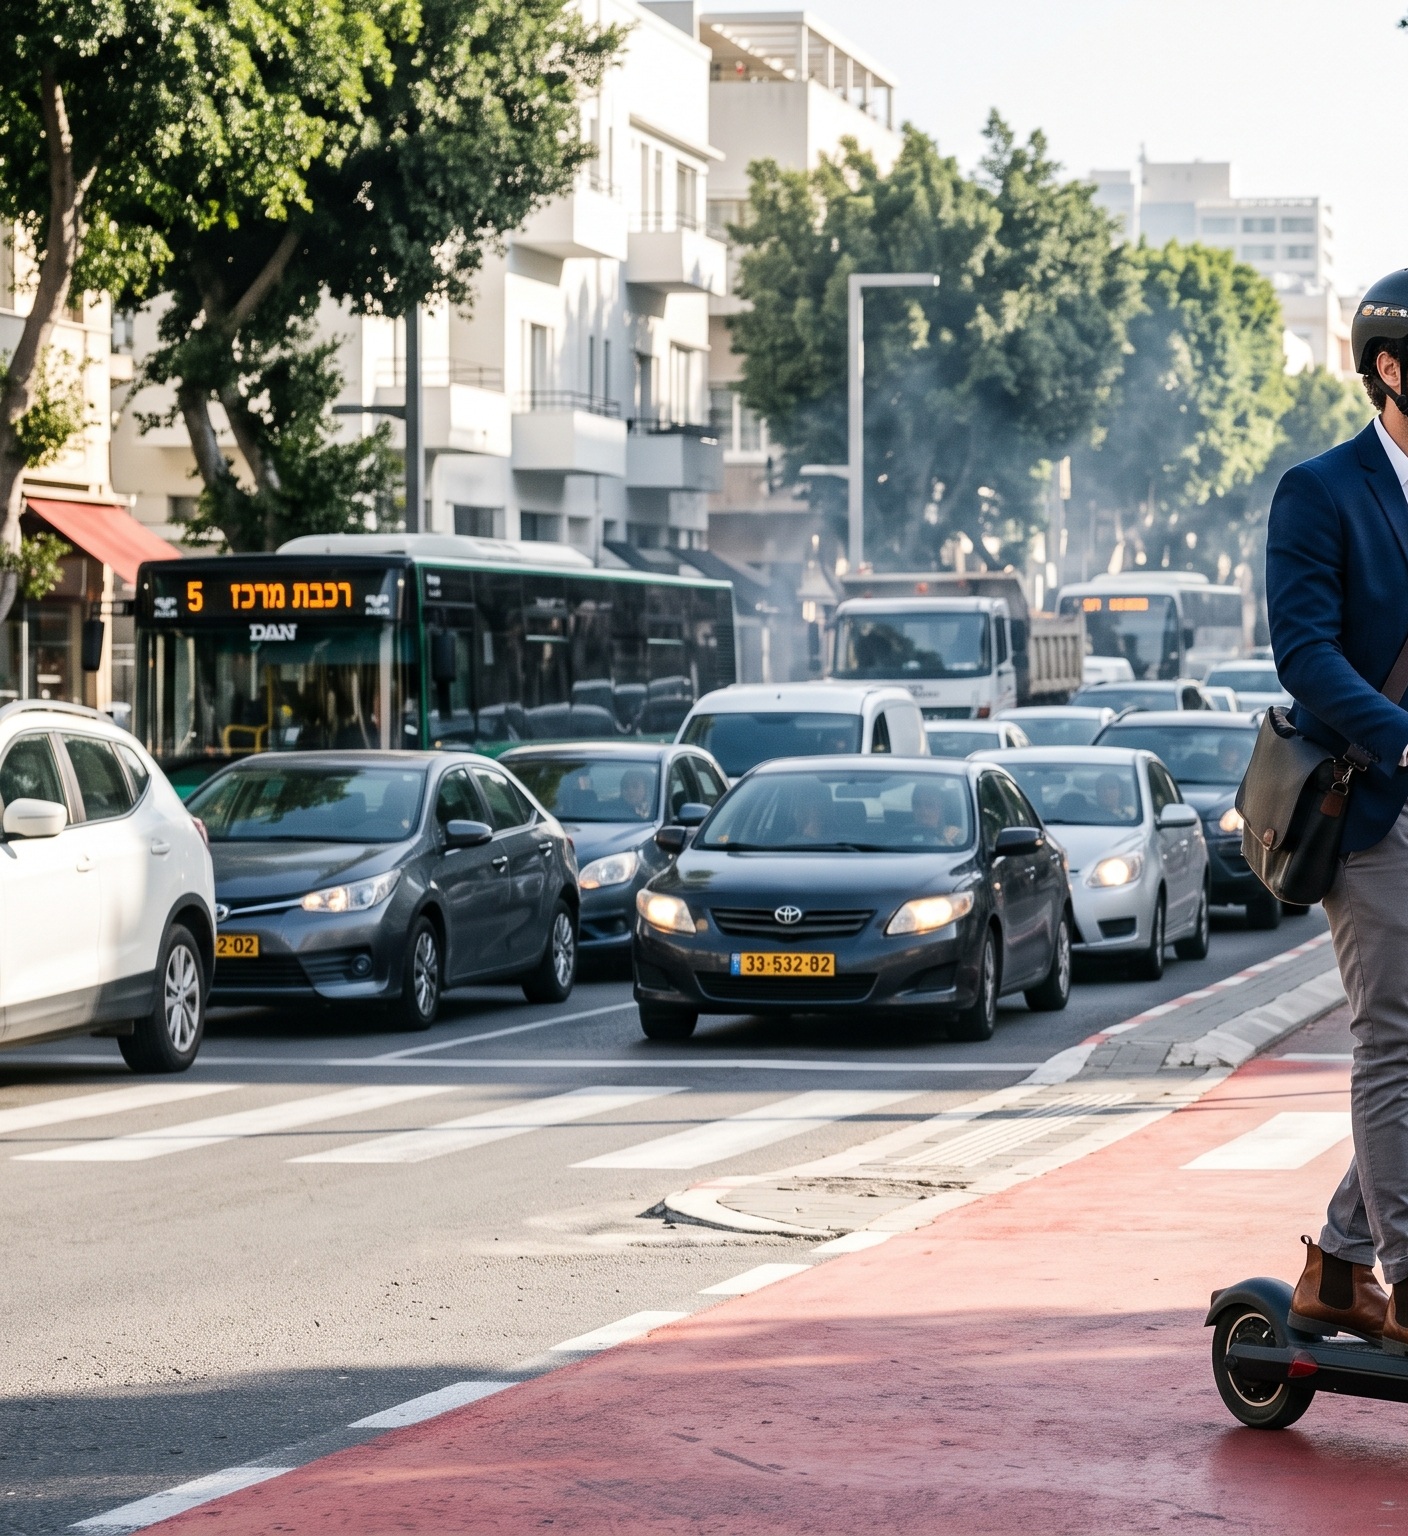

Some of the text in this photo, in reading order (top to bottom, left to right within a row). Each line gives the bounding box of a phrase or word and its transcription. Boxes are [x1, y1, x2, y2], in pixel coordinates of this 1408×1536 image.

[187, 581, 203, 611] 5
[230, 582, 352, 610] רכבת מרכז
[249, 623, 297, 641] DAN
